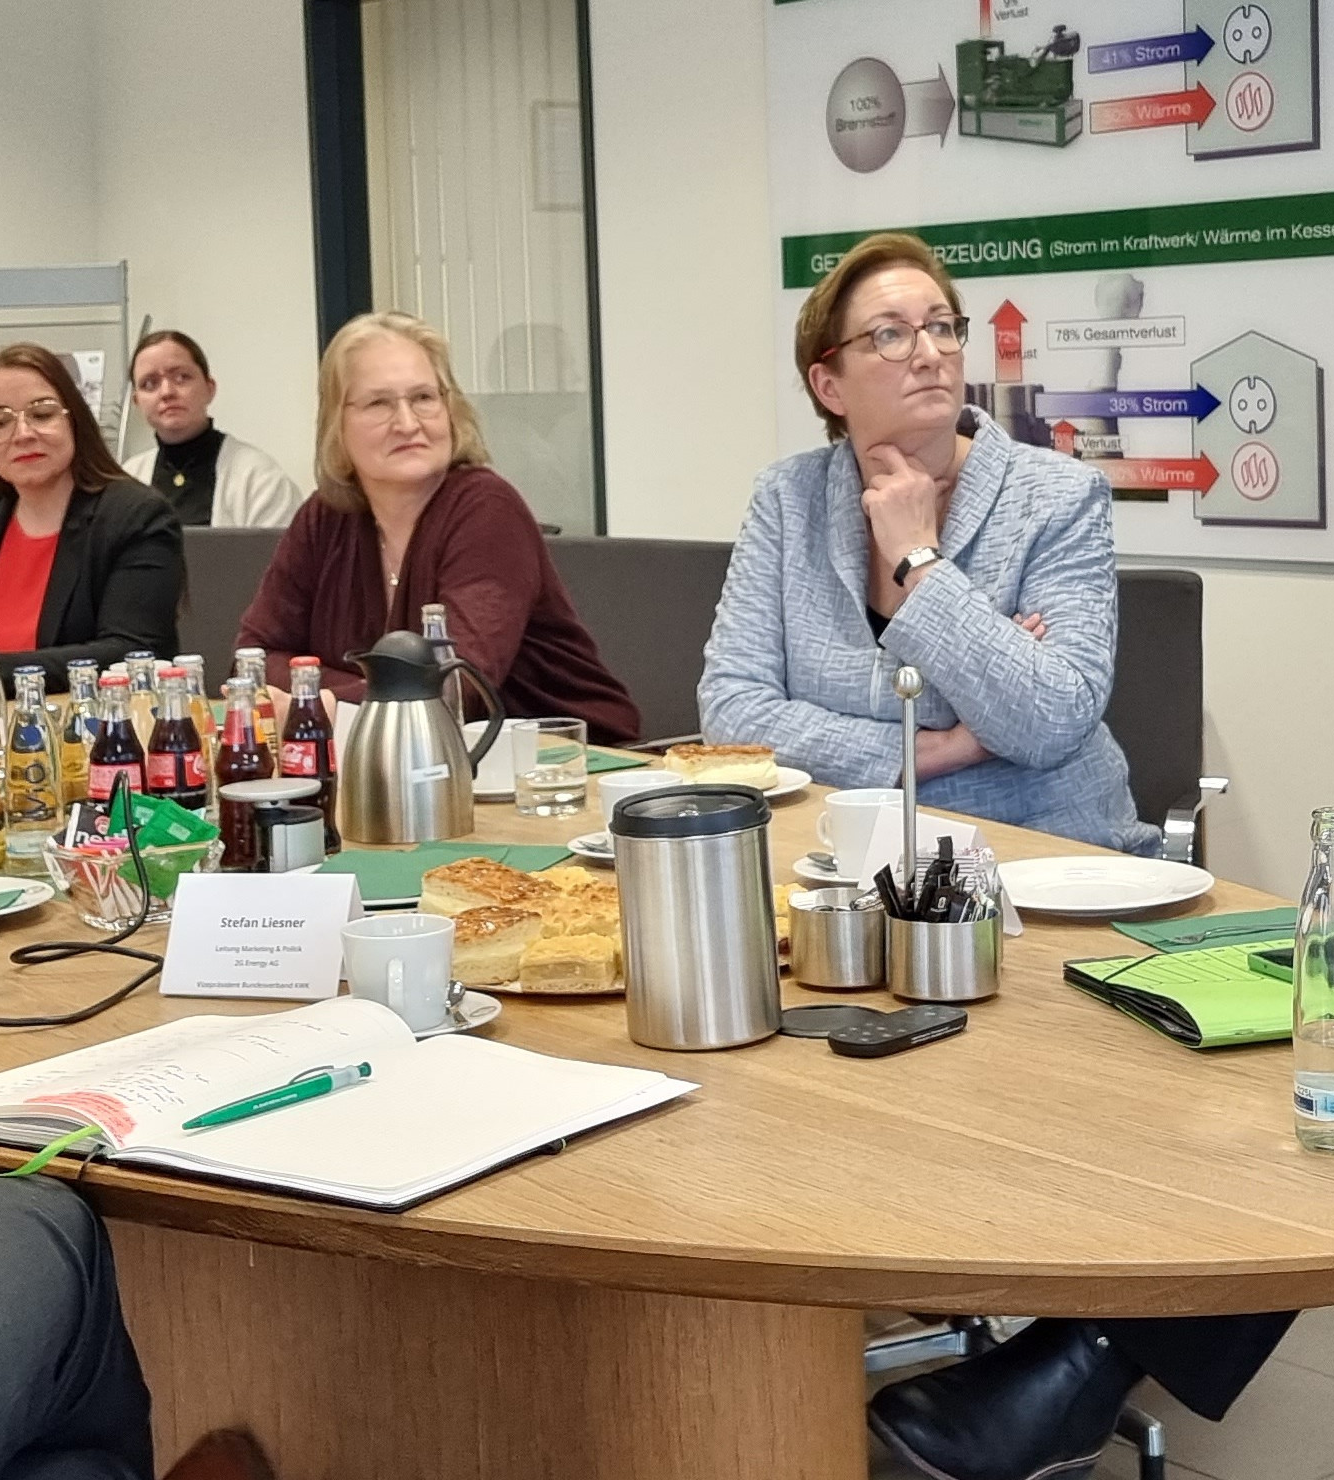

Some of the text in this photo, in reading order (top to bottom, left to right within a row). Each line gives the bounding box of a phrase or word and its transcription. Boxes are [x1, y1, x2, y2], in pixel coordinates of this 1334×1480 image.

[1135, 44, 1181, 62] Strom
[850, 96, 883, 112] 100%
[1136, 102, 1192, 121] Wärme
[835, 111, 896, 133] Brennstoff
[931, 238, 1044, 265] RZEUGUNG
[1049, 239, 1098, 259] (Strom
[1100, 238, 1120, 253] im
[1123, 230, 1200, 252] Kraftwerk/
[1202, 227, 1262, 246] Wärme
[1266, 225, 1287, 241] im
[1055, 325, 1177, 343] 78% Gesamtverlust
[1109, 396, 1188, 413] 38% Strom
[1081, 436, 1122, 450] Verlust
[1140, 466, 1196, 484] Wärme
[220, 917, 306, 928] Stefan Liesner
[245, 959, 268, 968] Energy
